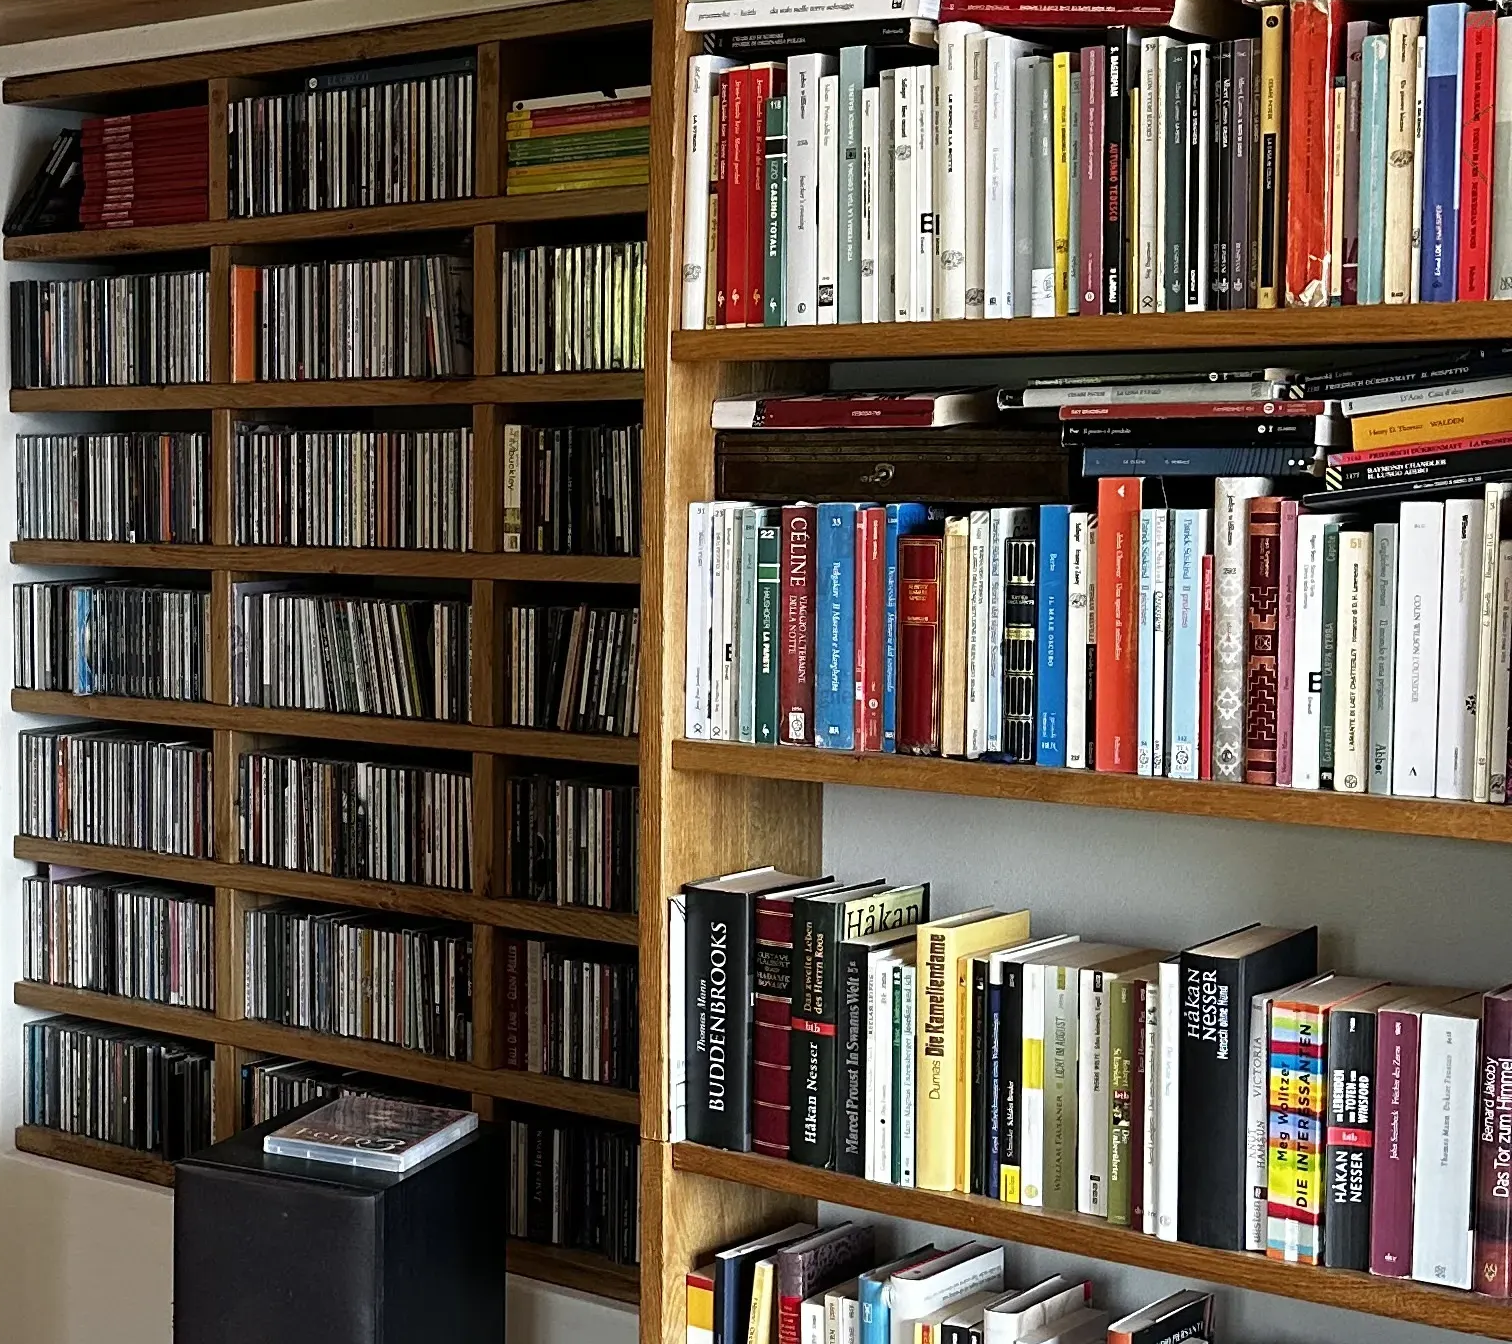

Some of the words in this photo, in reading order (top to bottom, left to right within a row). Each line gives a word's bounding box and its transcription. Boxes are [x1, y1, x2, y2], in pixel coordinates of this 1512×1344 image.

[1109, 143, 1118, 183] AUTUNNO
[770, 183, 778, 220] CASINO
[1109, 185, 1118, 222] TEDESCO
[769, 222, 777, 257] TOTALE
[1429, 417, 1464, 428] WALDEN
[760, 530, 775, 539] 22
[790, 517, 809, 587] CÉLINE
[789, 595, 797, 620] DELLA
[799, 595, 808, 628] VIAGGIO
[1048, 596, 1055, 605] IL
[763, 631, 770, 642] LA
[788, 621, 797, 654] NOTTE
[798, 641, 807, 684] TERMINE
[805, 921, 813, 954] Leben
[816, 933, 824, 963] Roos
[507, 945, 517, 977] MILLER
[804, 957, 812, 993] zweite
[697, 979, 706, 1009] Mann
[815, 967, 823, 998] Herrn
[847, 973, 859, 1004] Welt
[926, 934, 946, 1034] Kameliendame
[709, 921, 727, 1112] BUDDENBROOKS
[804, 995, 812, 1013] Das
[814, 999, 822, 1014] des
[696, 1012, 706, 1052] Thomas
[847, 1005, 859, 1048] Swanns
[846, 1049, 859, 1066] In
[925, 1037, 945, 1057] Die
[806, 1042, 818, 1091] Nesser
[929, 1059, 941, 1100] Dumas
[1253, 1037, 1262, 1098] VICTORIA
[1483, 1056, 1498, 1100] Jakoby
[1496, 1057, 1512, 1110] Himmel
[846, 1069, 859, 1108] Proust
[1278, 1061, 1290, 1126] Wolitzer
[1296, 1024, 1312, 1172] INTERESSANTEN
[804, 1094, 817, 1144] Håkan
[846, 1110, 859, 1155] Marcel
[1481, 1103, 1495, 1142] Bernard
[1497, 1114, 1511, 1142] zum
[1277, 1131, 1289, 1162] Meg
[1493, 1147, 1510, 1168] Tor
[1295, 1179, 1308, 1208] DIE
[1331, 1150, 1348, 1202] HÅKAN
[1350, 1152, 1363, 1203] NESSER
[1492, 1171, 1509, 1198] Das
